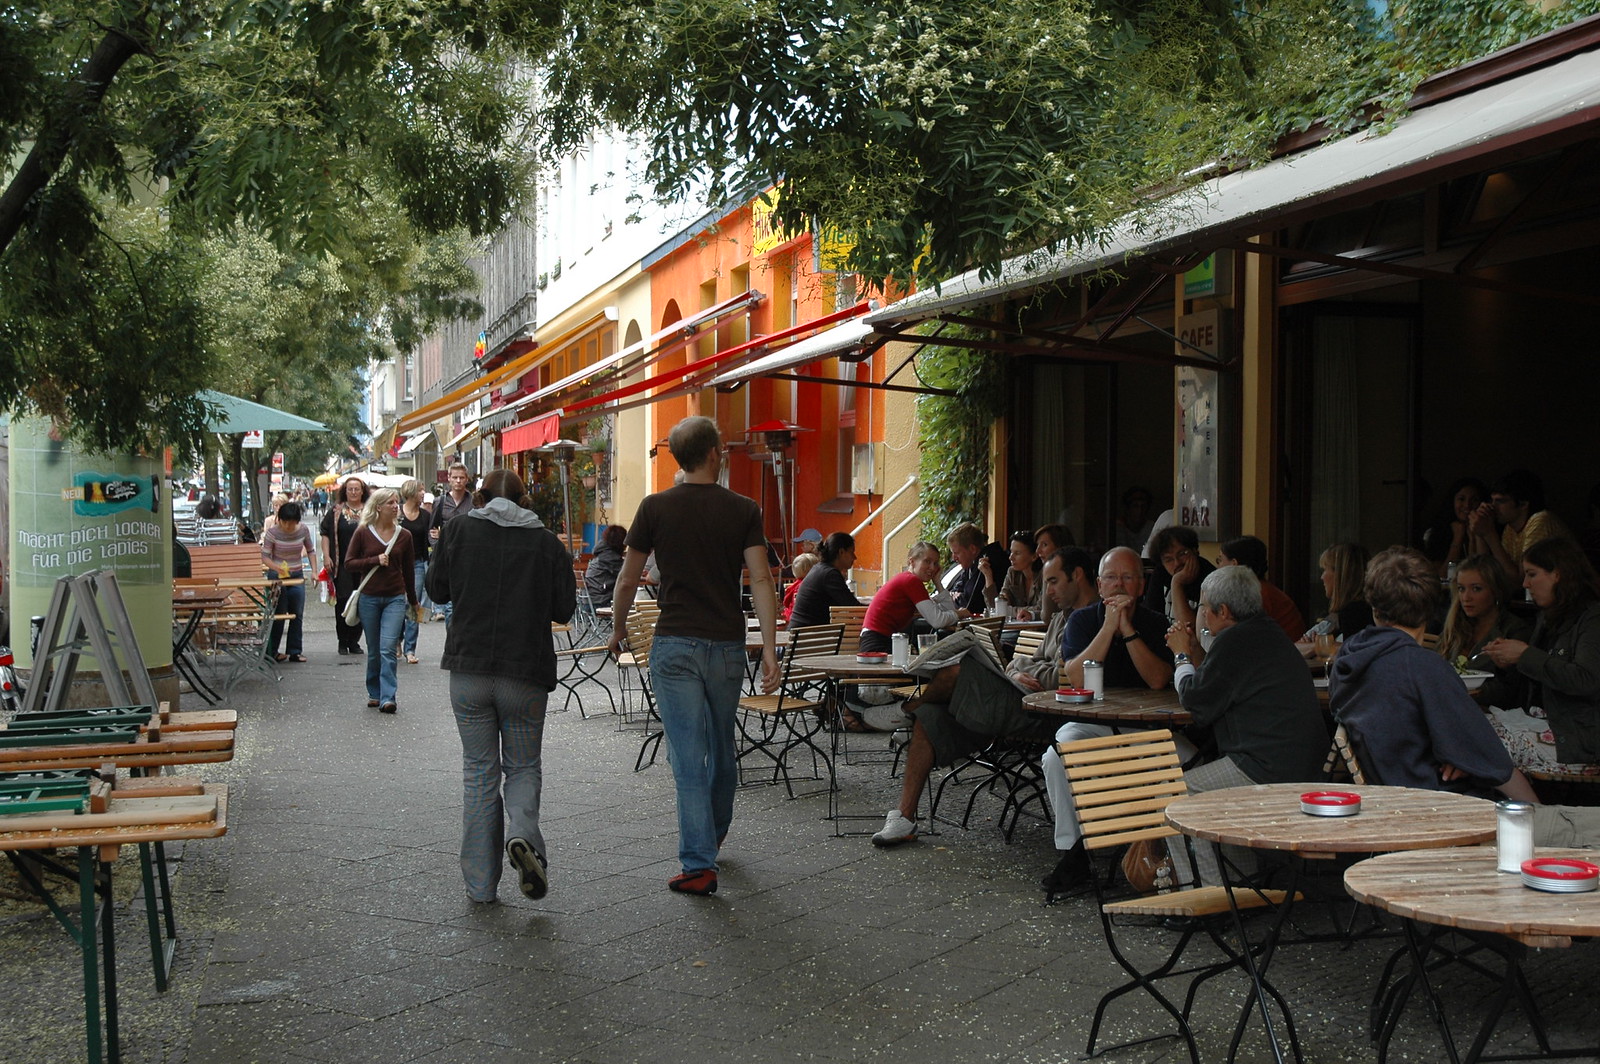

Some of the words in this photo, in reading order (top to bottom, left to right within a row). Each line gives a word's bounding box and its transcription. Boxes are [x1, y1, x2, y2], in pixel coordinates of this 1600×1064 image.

[1180, 325, 1213, 350] CAFE
[1182, 505, 1210, 527] BAR
[19, 529, 65, 549] MACHT
[71, 524, 108, 545] DICH
[115, 521, 161, 540] LOCKER
[32, 551, 60, 568] FÜR
[67, 544, 92, 565] DIE
[100, 538, 149, 559] LADIES
